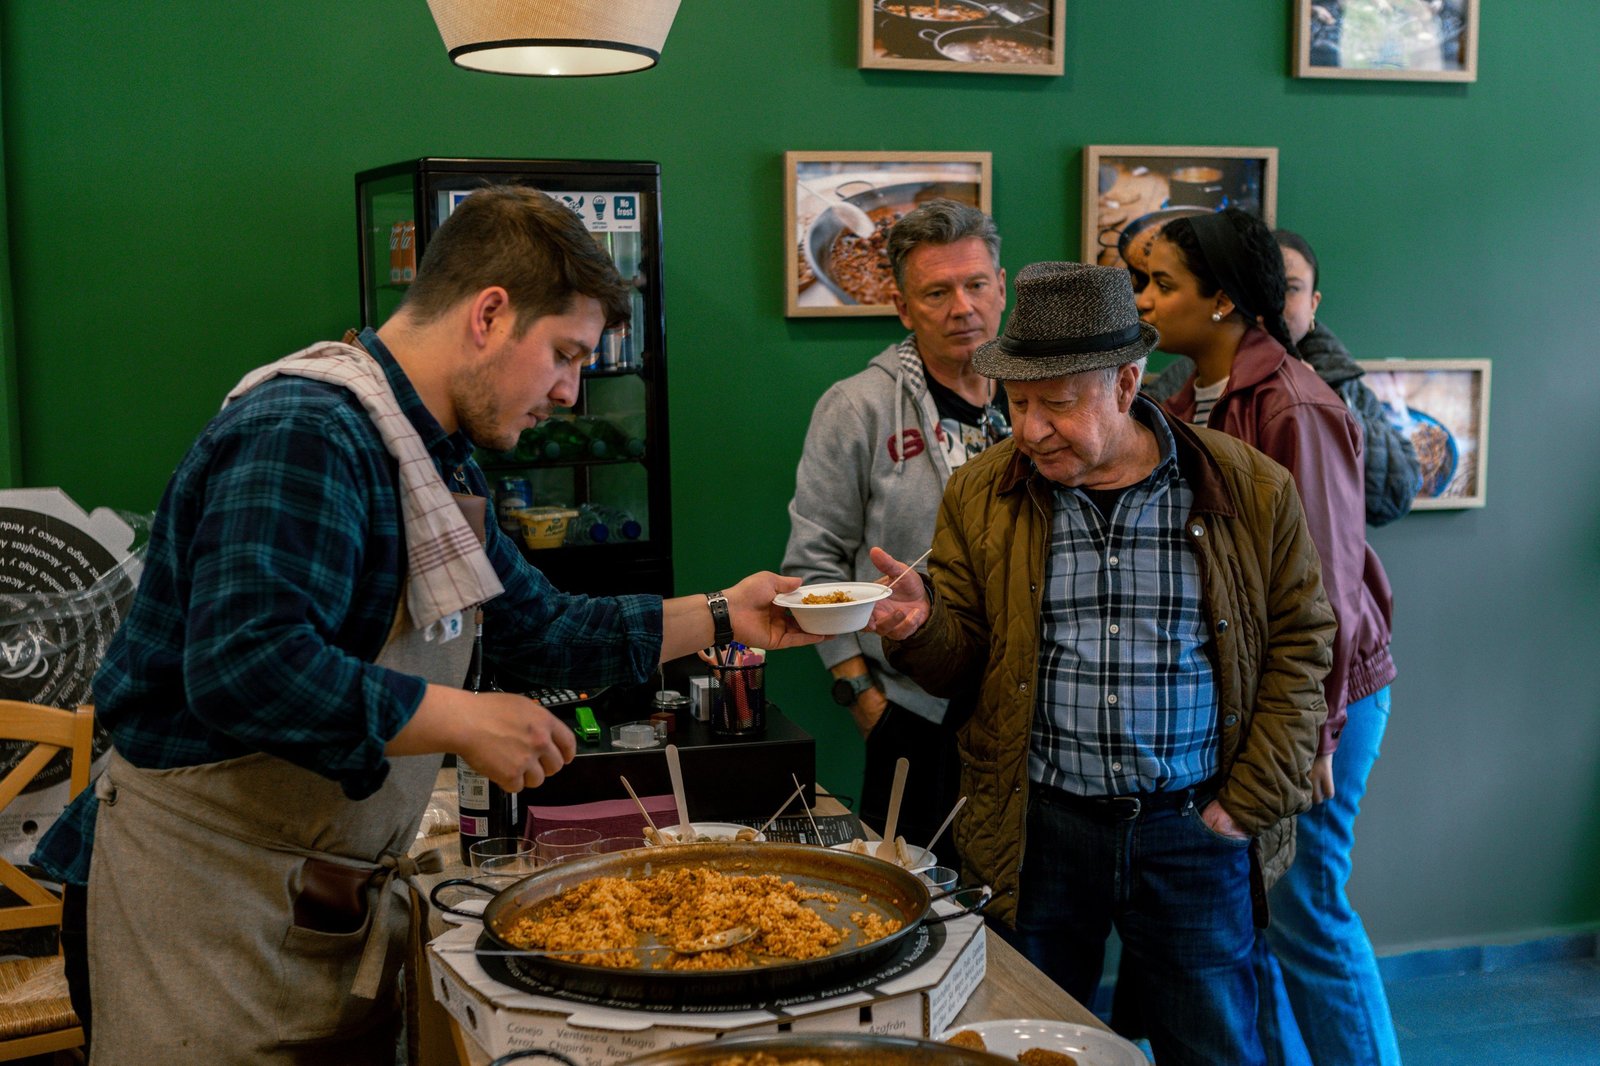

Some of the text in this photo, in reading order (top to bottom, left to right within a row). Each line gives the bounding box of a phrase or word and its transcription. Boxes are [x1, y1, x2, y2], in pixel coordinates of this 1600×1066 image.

[620, 198, 630, 208] No
[616, 207, 634, 216] frost
[0, 521, 24, 535] Verdu
[28, 526, 38, 535] y
[38, 530, 66, 550] Ibérico
[9, 557, 17, 567] y
[11, 540, 62, 568] Alcachofitas
[66, 546, 90, 569] Magro
[19, 561, 38, 576] Roja
[62, 565, 72, 573] y
[0, 575, 25, 589] Alcac
[26, 584, 36, 592] y
[40, 571, 69, 599] Gambita
[69, 572, 86, 592] Pollo
[74, 643, 86, 670] Banda
[681, 1003, 751, 1013] Ventresca
[774, 994, 815, 1007] Ajetes
[507, 1023, 543, 1036] Conejo
[557, 1028, 609, 1044] Ventresca
[622, 1035, 656, 1049] Magro
[870, 1020, 906, 1036] Azafrán
[507, 1036, 535, 1049] Arroz
[549, 1040, 593, 1055] Chipirón
